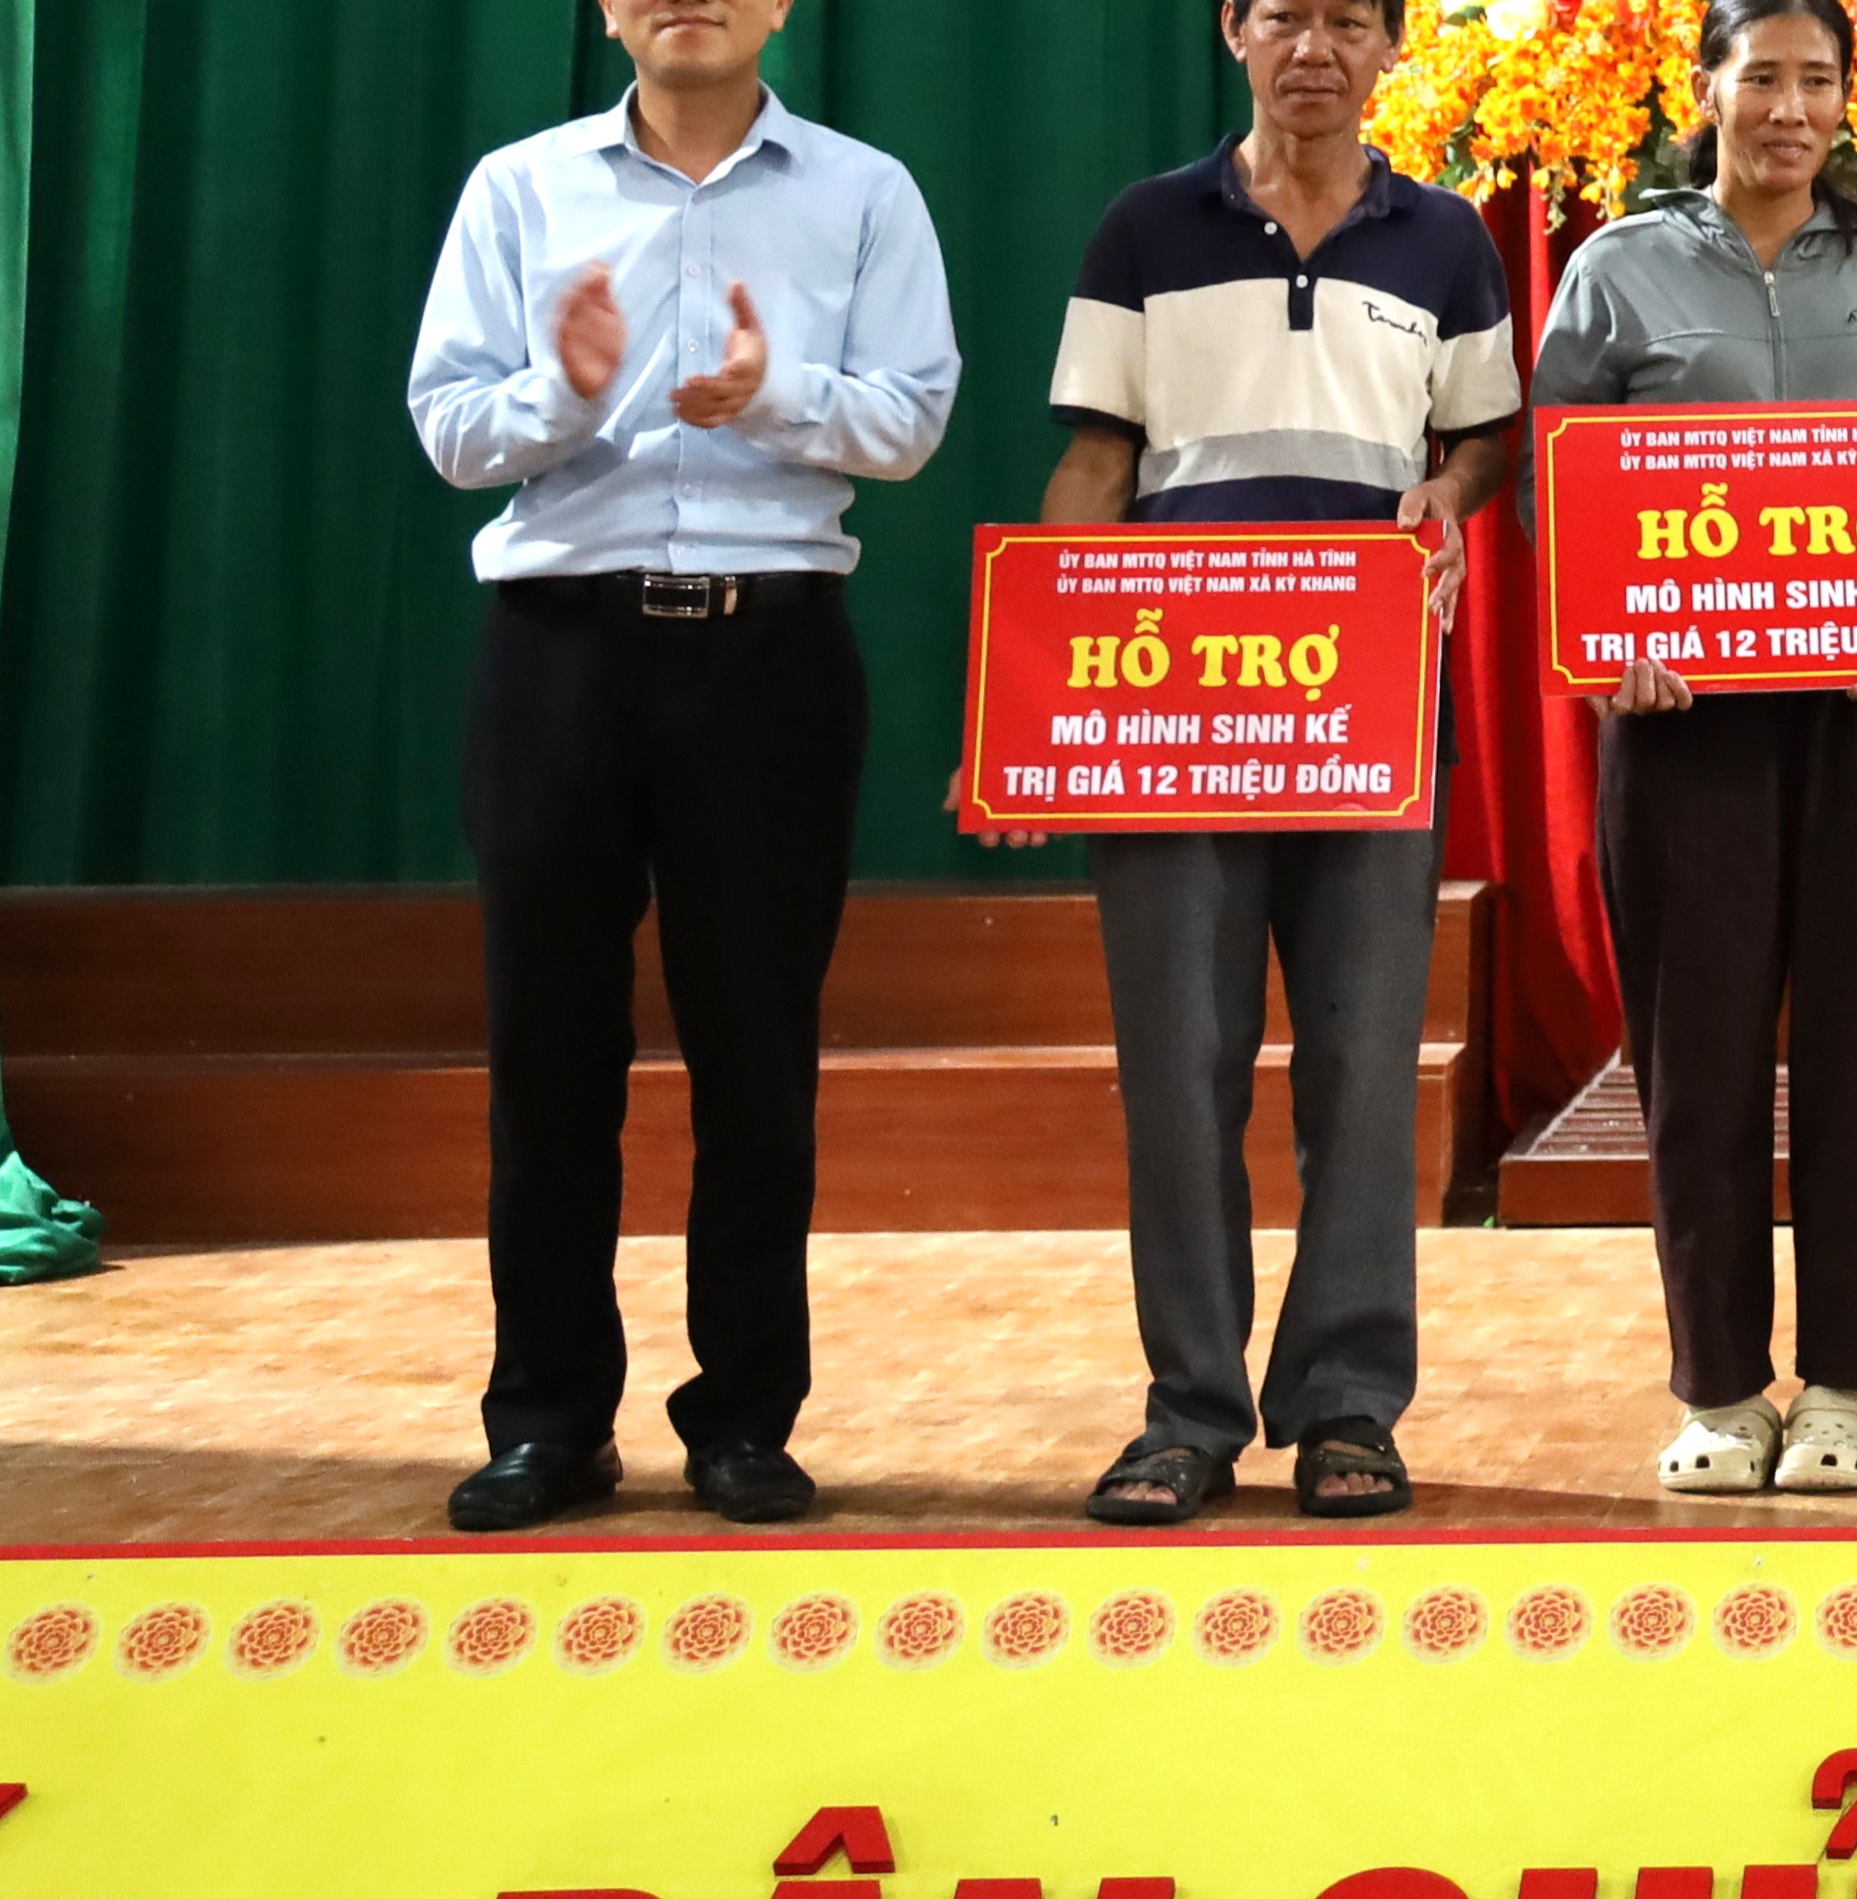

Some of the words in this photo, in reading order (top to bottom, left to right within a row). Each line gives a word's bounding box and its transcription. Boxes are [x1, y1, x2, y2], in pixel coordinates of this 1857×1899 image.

[1621, 429, 1641, 447] ỦY
[1646, 432, 1680, 446] BAN
[1684, 430, 1727, 446] MTTQ
[1732, 427, 1765, 447] VIỆT
[1770, 429, 1807, 443] NAM
[1811, 424, 1848, 443] TỈNH
[1637, 483, 1739, 559] HỖ
[1060, 550, 1079, 568] ỦY
[1085, 554, 1118, 568] BAN
[1123, 553, 1166, 569] MTTQ
[1171, 550, 1204, 570] VIỆT
[1209, 553, 1246, 567] NAM
[1252, 548, 1288, 567] TỈNH
[1293, 550, 1314, 566] HÀ
[1319, 549, 1356, 566] TĨNH
[1058, 575, 1077, 593] ỦY
[1082, 578, 1116, 593] BAN
[1121, 578, 1164, 594] MTTQ
[1169, 575, 1202, 595] VIỆT
[1207, 577, 1244, 592] NAM
[1250, 575, 1271, 591] XÃ
[1276, 574, 1296, 591] KỲ
[1301, 576, 1356, 591] KHANG
[1626, 579, 1680, 613] MÔ
[1692, 578, 1774, 611] HÌNH
[1067, 608, 1170, 688] HỖ
[1192, 625, 1339, 701] TRỢ
[1581, 633, 1634, 667] TRỊ
[1647, 626, 1704, 659] GIÁ
[1716, 630, 1756, 657] 12
[1052, 709, 1106, 745] MÔ
[1117, 709, 1200, 744] HÌNH
[1212, 714, 1294, 743] SINH
[1306, 704, 1351, 743] KẾ
[1004, 766, 1056, 801] TRỊ
[1068, 760, 1124, 795] GIÁ
[1138, 766, 1177, 794] 12
[1188, 759, 1285, 800] TRIỆU
[1296, 754, 1391, 793] ĐỒNG
